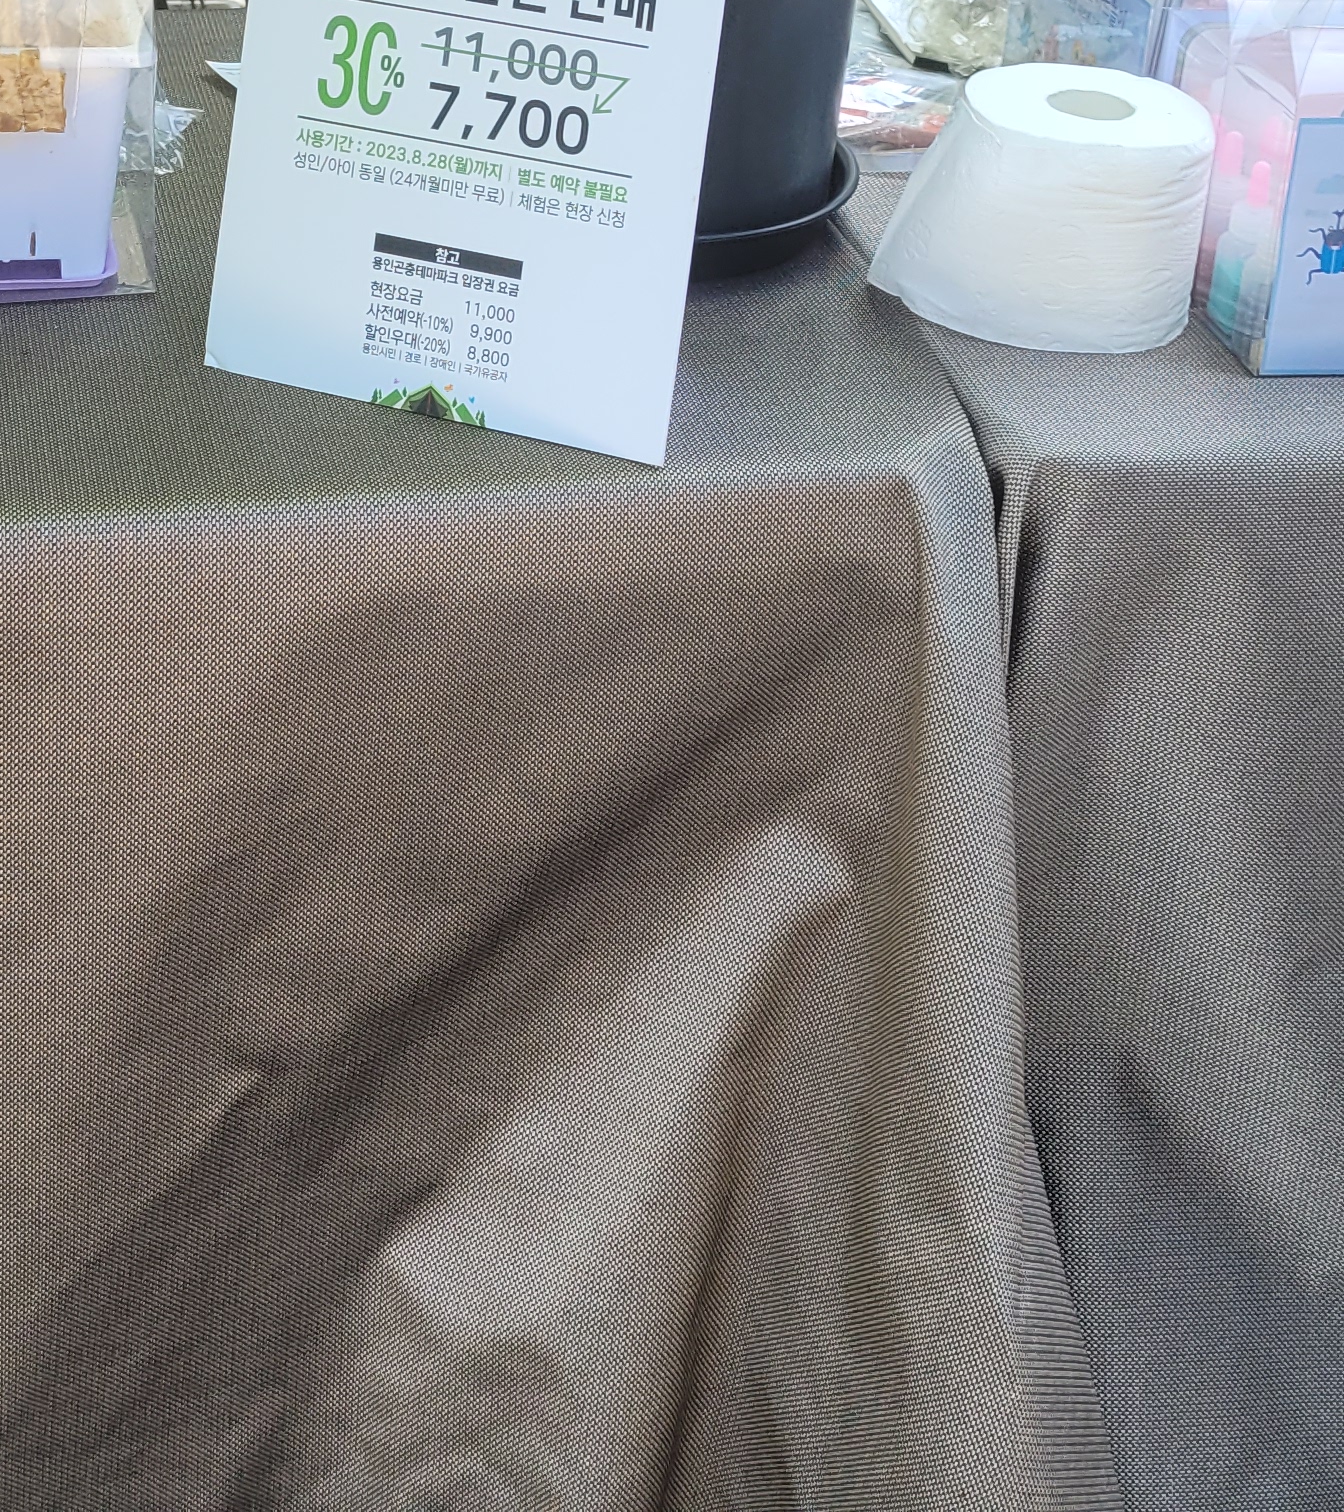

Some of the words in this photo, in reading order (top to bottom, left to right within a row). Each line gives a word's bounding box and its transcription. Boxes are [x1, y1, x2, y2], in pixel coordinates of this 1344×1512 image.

[435, 26, 598, 91] 11,000
[429, 81, 589, 155] 7,700
[293, 152, 356, 178] 성인/아이
[358, 163, 386, 183] 동일
[389, 168, 469, 199] (24개월미만
[472, 184, 505, 206] 무료)
[517, 193, 561, 216] 체험은
[565, 201, 593, 223] 현장
[596, 208, 626, 229] 신청
[366, 141, 503, 181] 2023.8.28(월)까지
[517, 167, 546, 189] 별도
[550, 174, 581, 196] 예약
[584, 180, 628, 204] 불필요
[372, 256, 459, 284] 용인곤충테마파크
[461, 274, 495, 292] 입장권
[496, 281, 520, 298] 요금
[435, 248, 460, 265] 참고
[370, 280, 424, 306] 현장요금
[464, 300, 515, 323] 11,000
[364, 324, 451, 356] 할인우대(-20%)
[467, 346, 510, 367] 8,800
[366, 303, 454, 334] 사전예약(-10%)
[470, 324, 512, 345] 9,900
[362, 343, 397, 360] 용인시민
[404, 351, 422, 364] 경로
[429, 357, 456, 372] 장애인
[464, 363, 508, 383] 국가유공자
